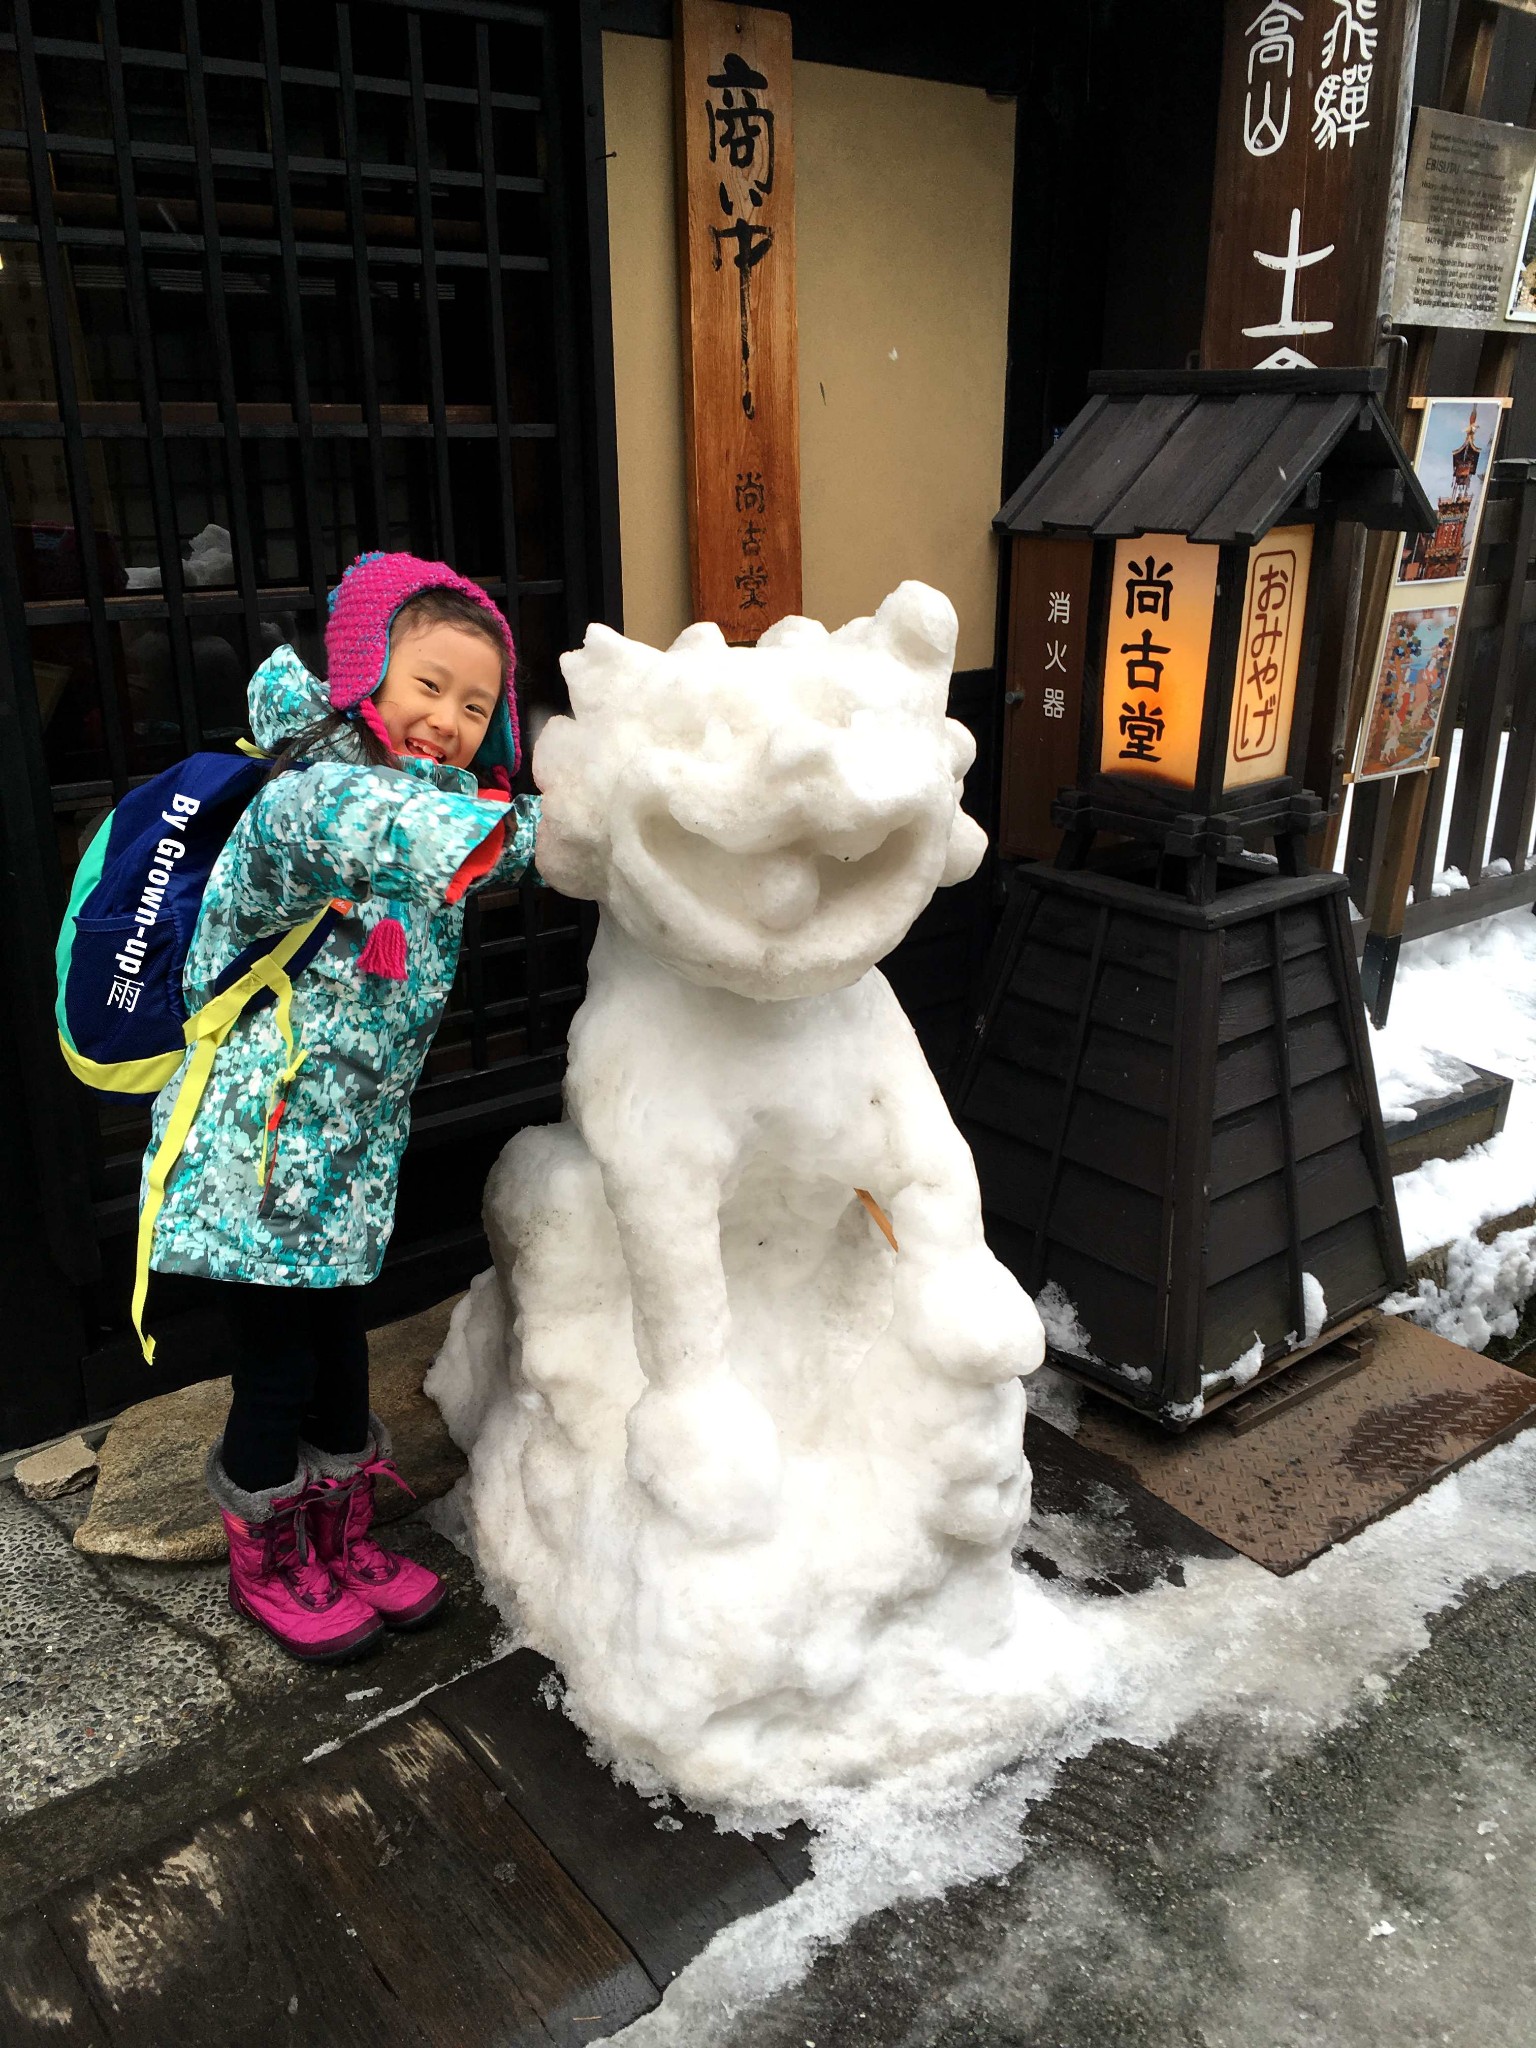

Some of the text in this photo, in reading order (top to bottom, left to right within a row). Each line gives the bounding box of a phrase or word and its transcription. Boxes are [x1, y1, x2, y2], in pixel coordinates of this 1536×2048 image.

[706, 53, 775, 420] 商い中
[735, 472, 769, 610] 尚古堂
[1042, 590, 1071, 719] 消火器
[1118, 555, 1174, 763] 尚古堂
[1241, 564, 1289, 750] おみやげ
